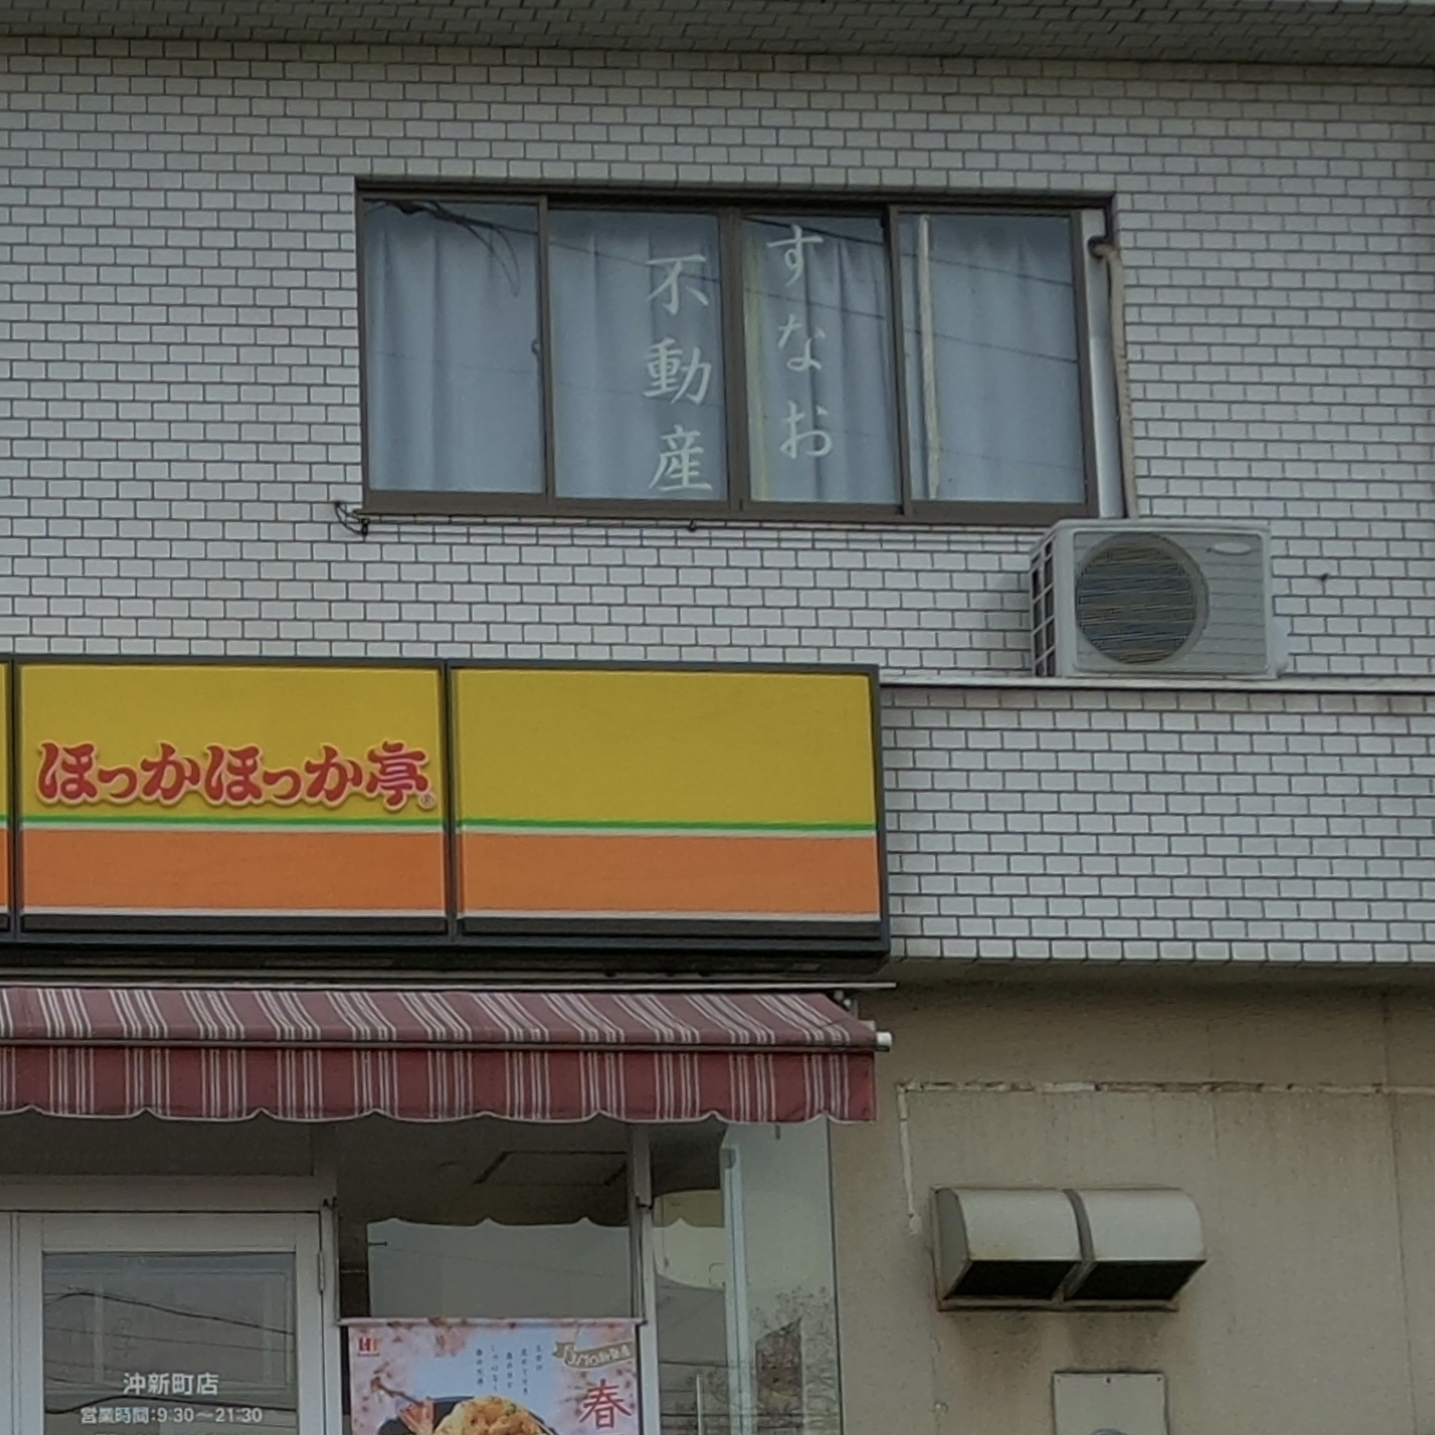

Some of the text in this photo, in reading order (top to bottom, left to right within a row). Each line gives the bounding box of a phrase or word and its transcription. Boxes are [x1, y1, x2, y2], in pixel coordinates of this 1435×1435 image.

[643, 252, 714, 491] 不動産
[766, 222, 835, 461] すなお
[37, 739, 430, 809] ほっかほっか亭
[123, 1372, 220, 1396] 沖新町店
